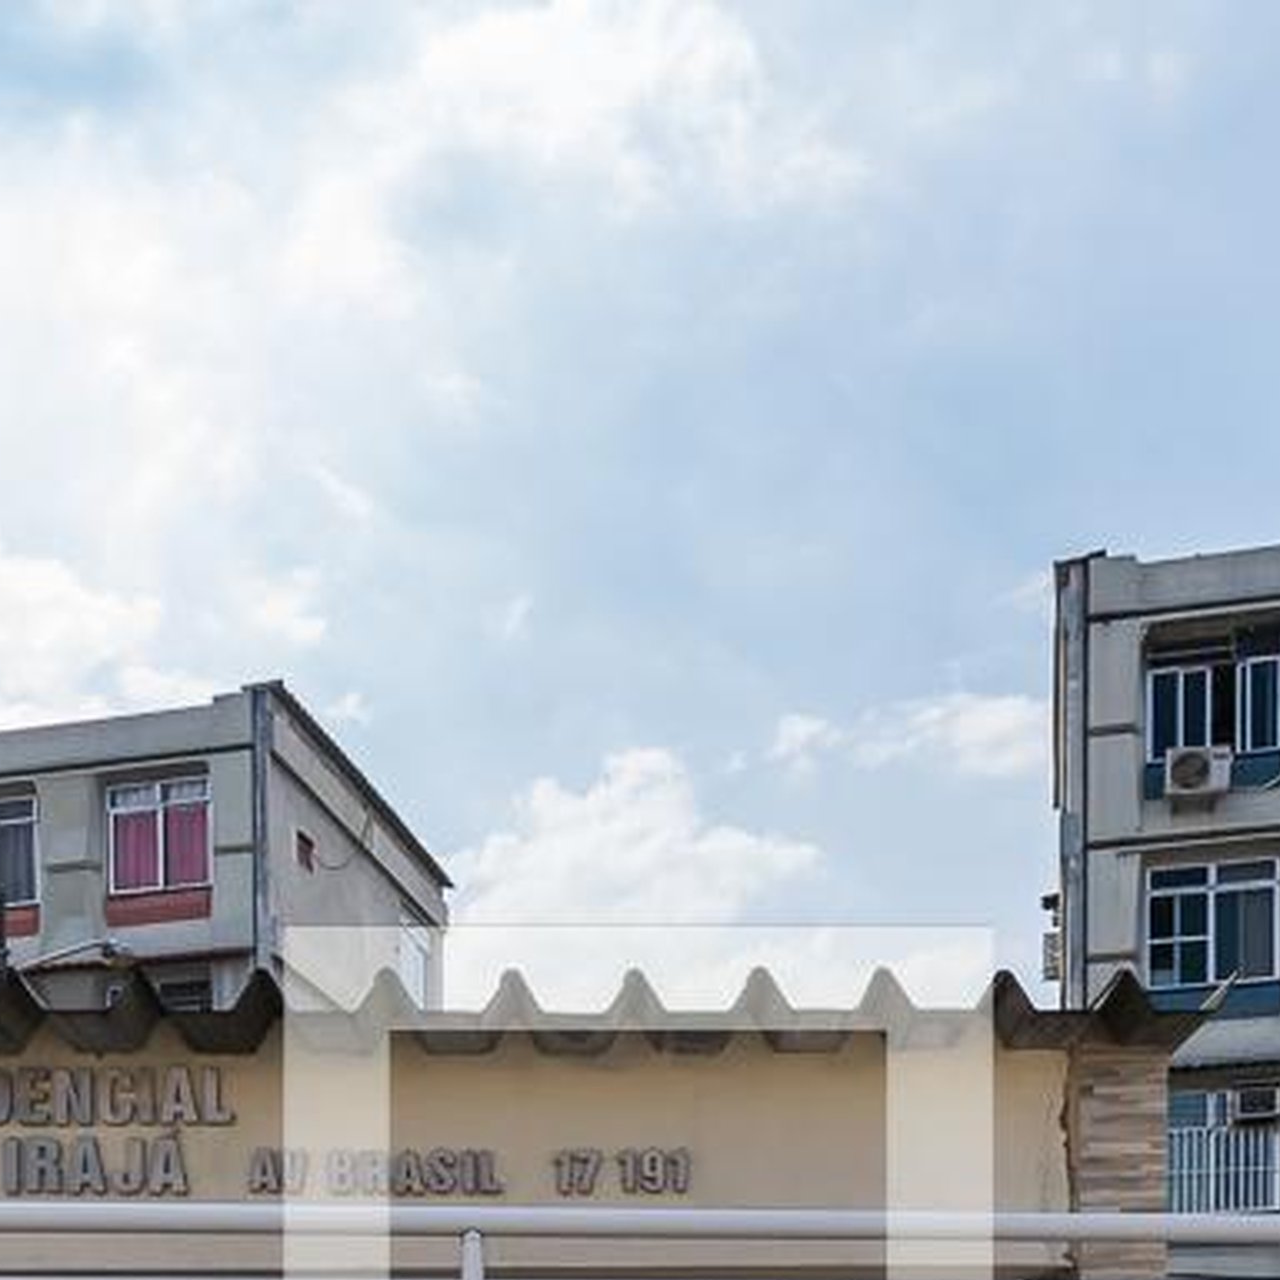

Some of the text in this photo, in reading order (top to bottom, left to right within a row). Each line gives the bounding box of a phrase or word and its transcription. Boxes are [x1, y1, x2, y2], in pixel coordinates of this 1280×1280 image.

[4, 1128, 188, 1196] IRAJÁ
[249, 1147, 691, 1197] AV BRASIL 17 191
